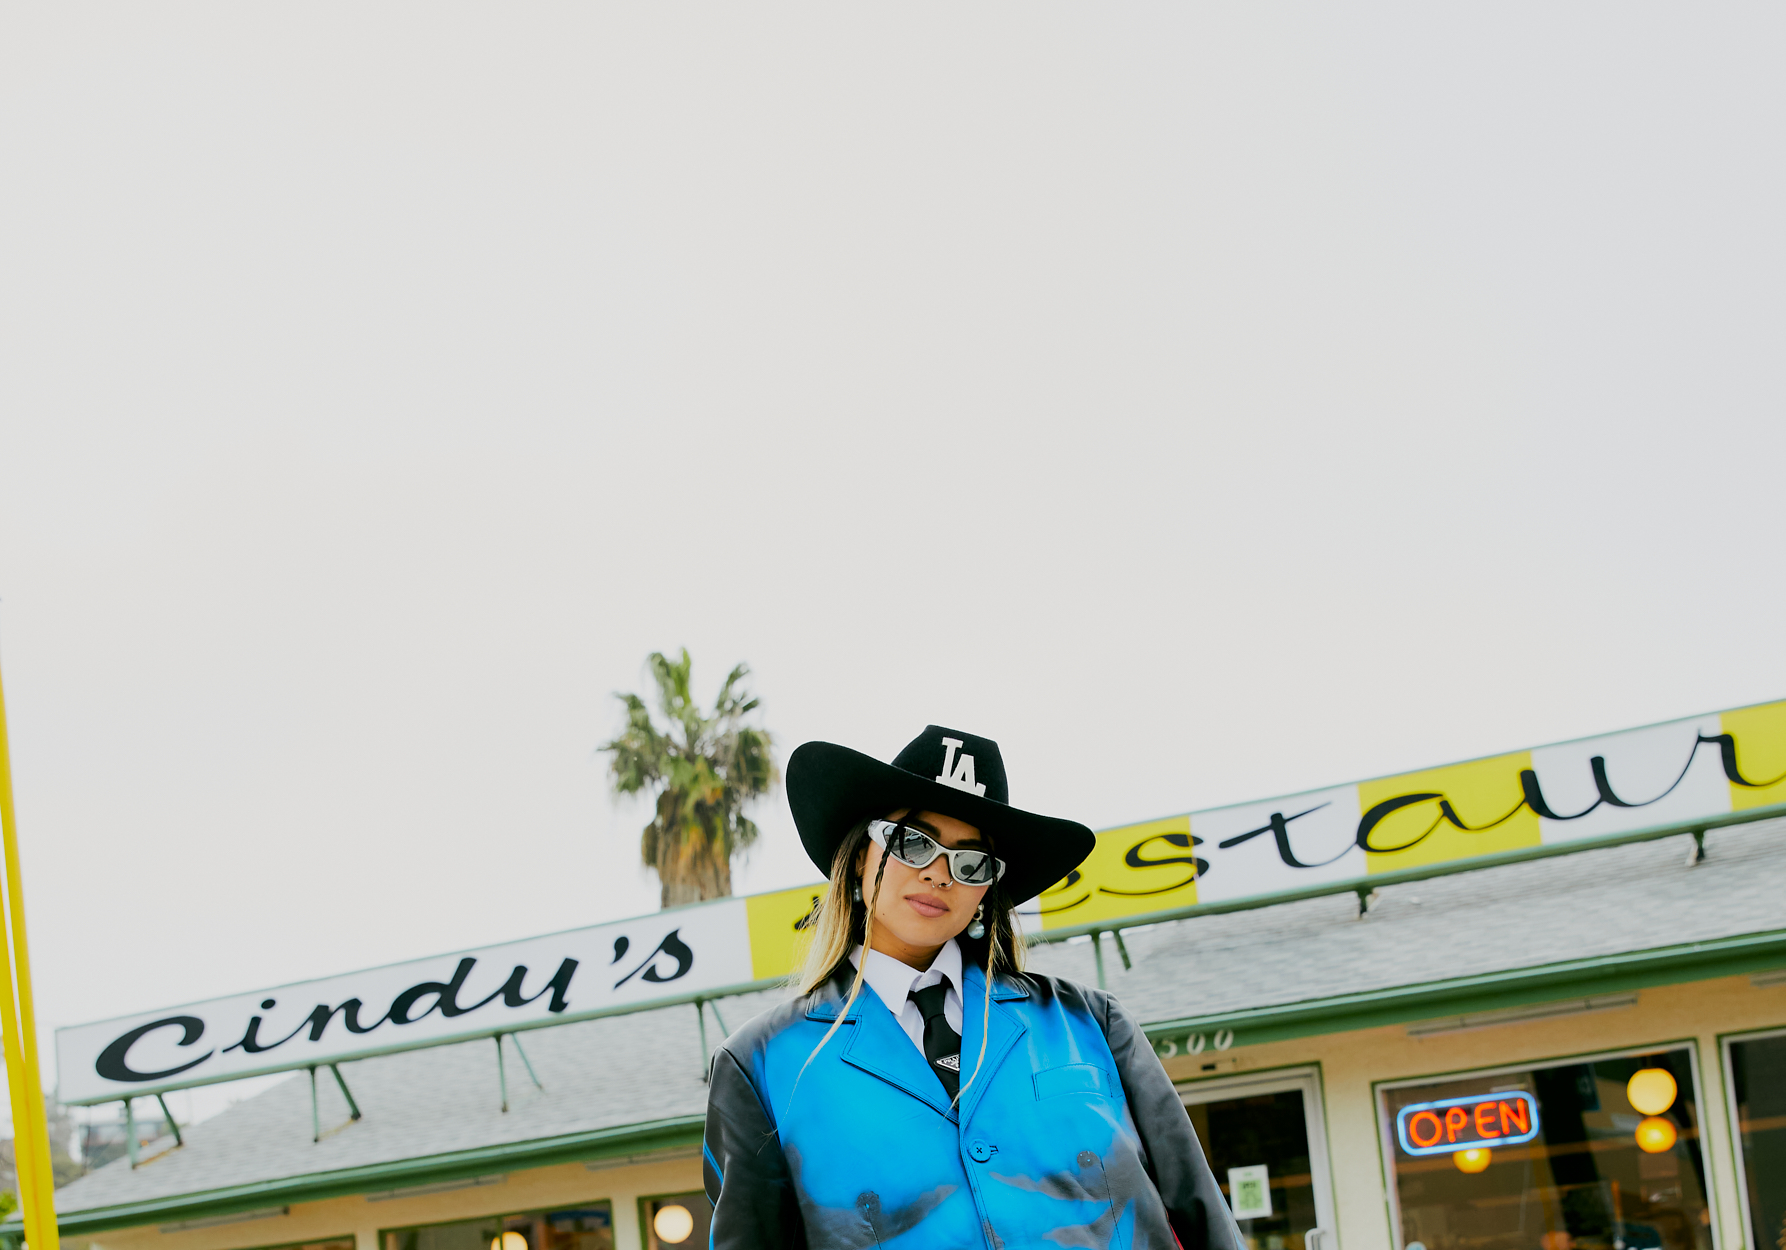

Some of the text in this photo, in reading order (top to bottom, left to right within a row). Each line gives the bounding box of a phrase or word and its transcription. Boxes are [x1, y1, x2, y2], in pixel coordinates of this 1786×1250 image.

[935, 736, 987, 798] LA
[95, 727, 1786, 1082] Cindy's staur
[1151, 1028, 1235, 1060] 500
[1409, 1098, 1529, 1148] OPEN
